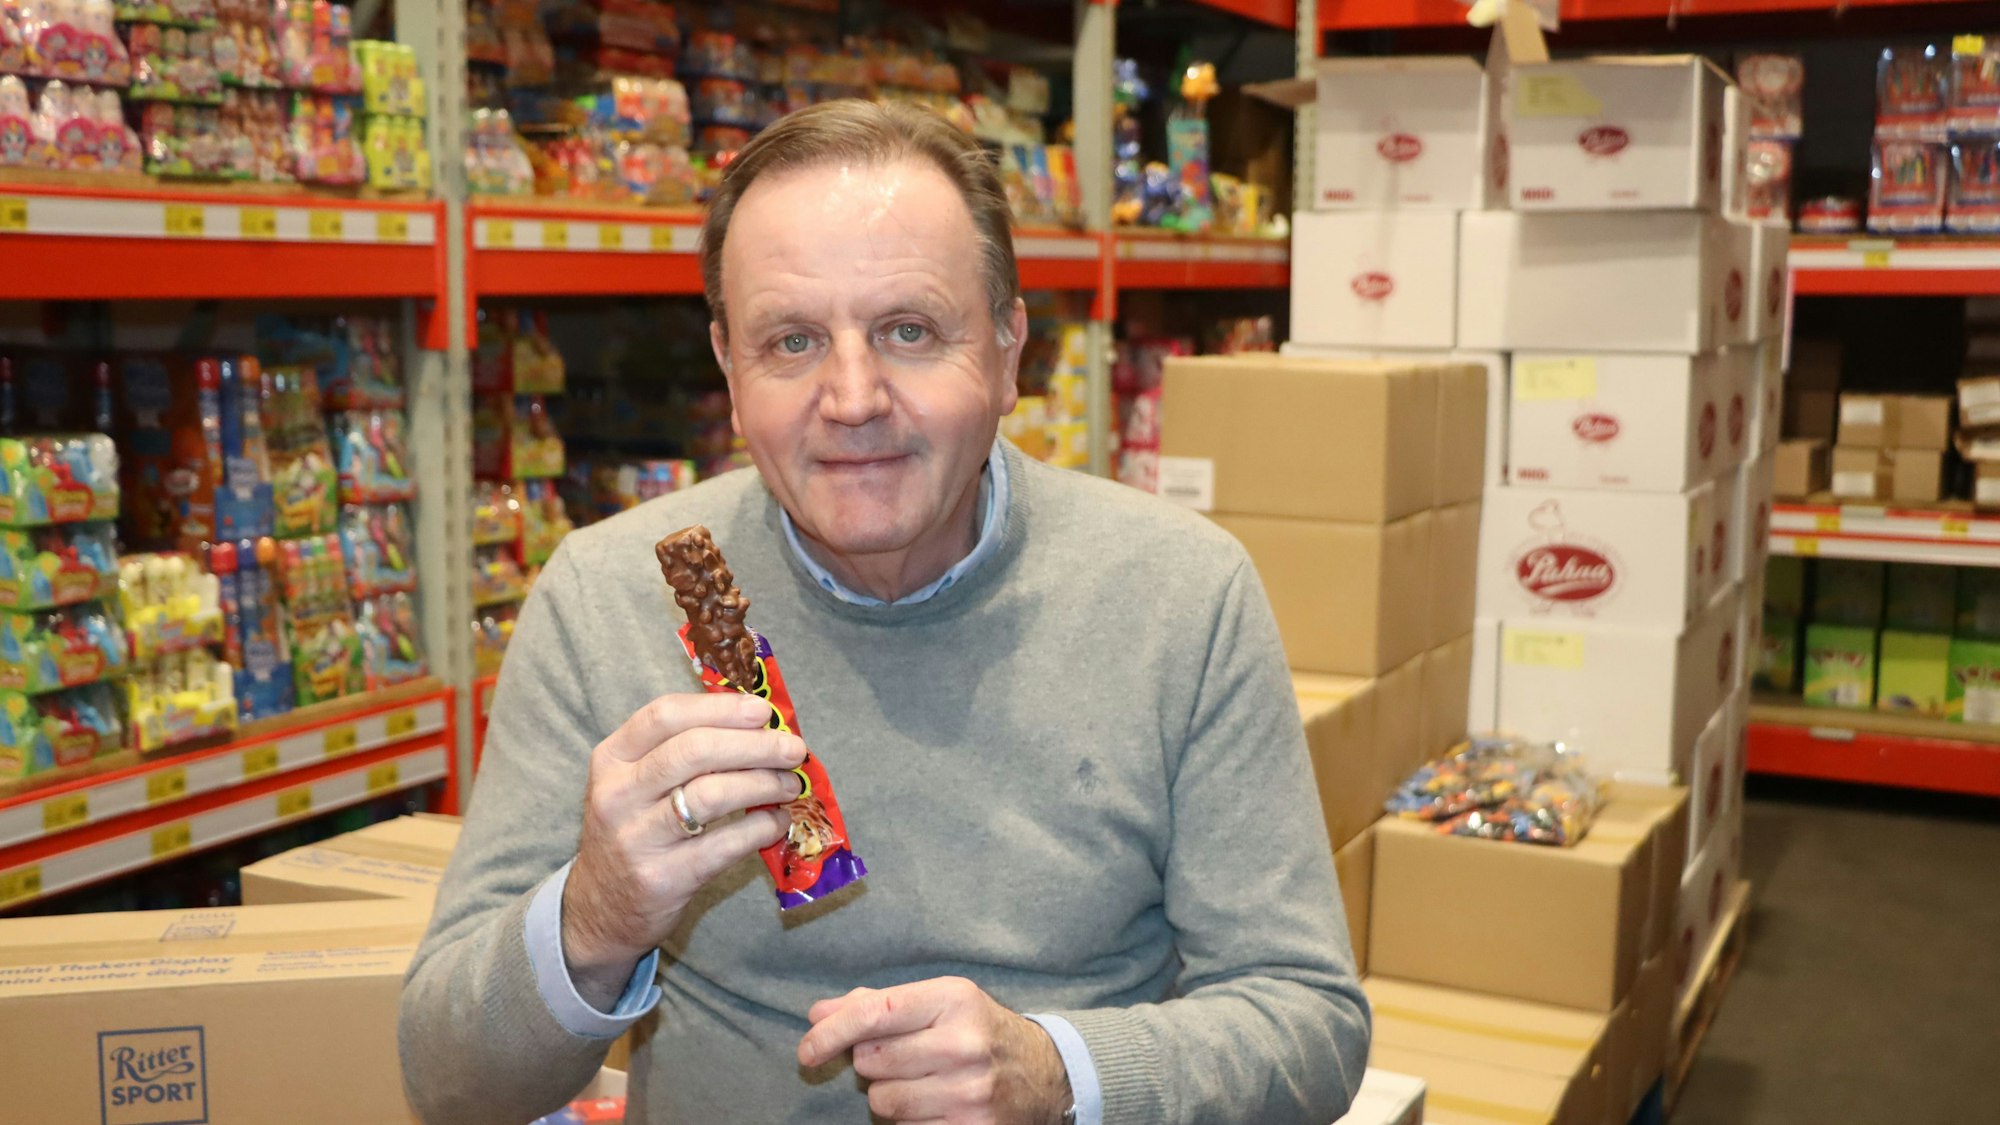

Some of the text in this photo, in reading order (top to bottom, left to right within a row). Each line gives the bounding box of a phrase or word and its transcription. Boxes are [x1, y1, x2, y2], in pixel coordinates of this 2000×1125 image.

[48, 971, 139, 983] counter
[146, 966, 232, 977] display
[110, 1046, 195, 1083] Ritter
[111, 1082, 196, 1106] SPORT
